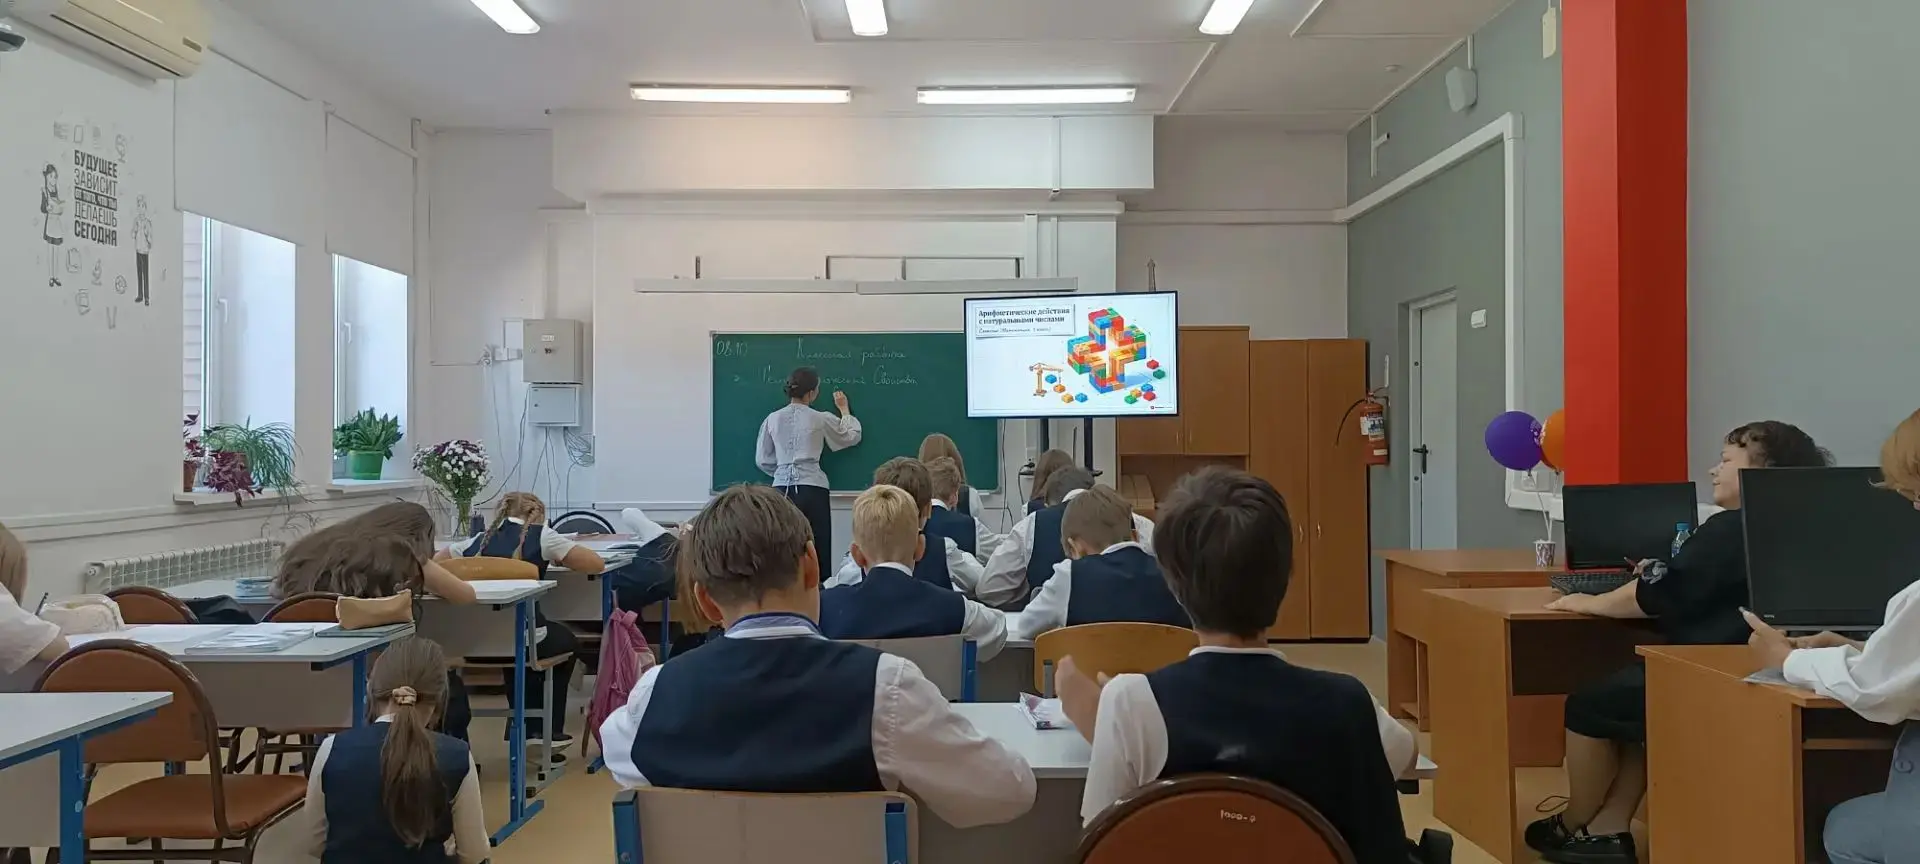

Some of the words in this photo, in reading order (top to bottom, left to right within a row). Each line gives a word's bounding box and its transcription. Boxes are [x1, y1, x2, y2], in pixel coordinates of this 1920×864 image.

[75, 150, 117, 178] БУДУЩЕЕ
[74, 168, 117, 197] ЗАВИСИТ
[75, 201, 117, 227] ДЕЛАЕШЬ
[75, 220, 117, 247] СЕГОДНЯ
[979, 309, 1037, 318] Арифметические
[1038, 307, 1070, 316] действия
[984, 317, 1034, 325] натуральными
